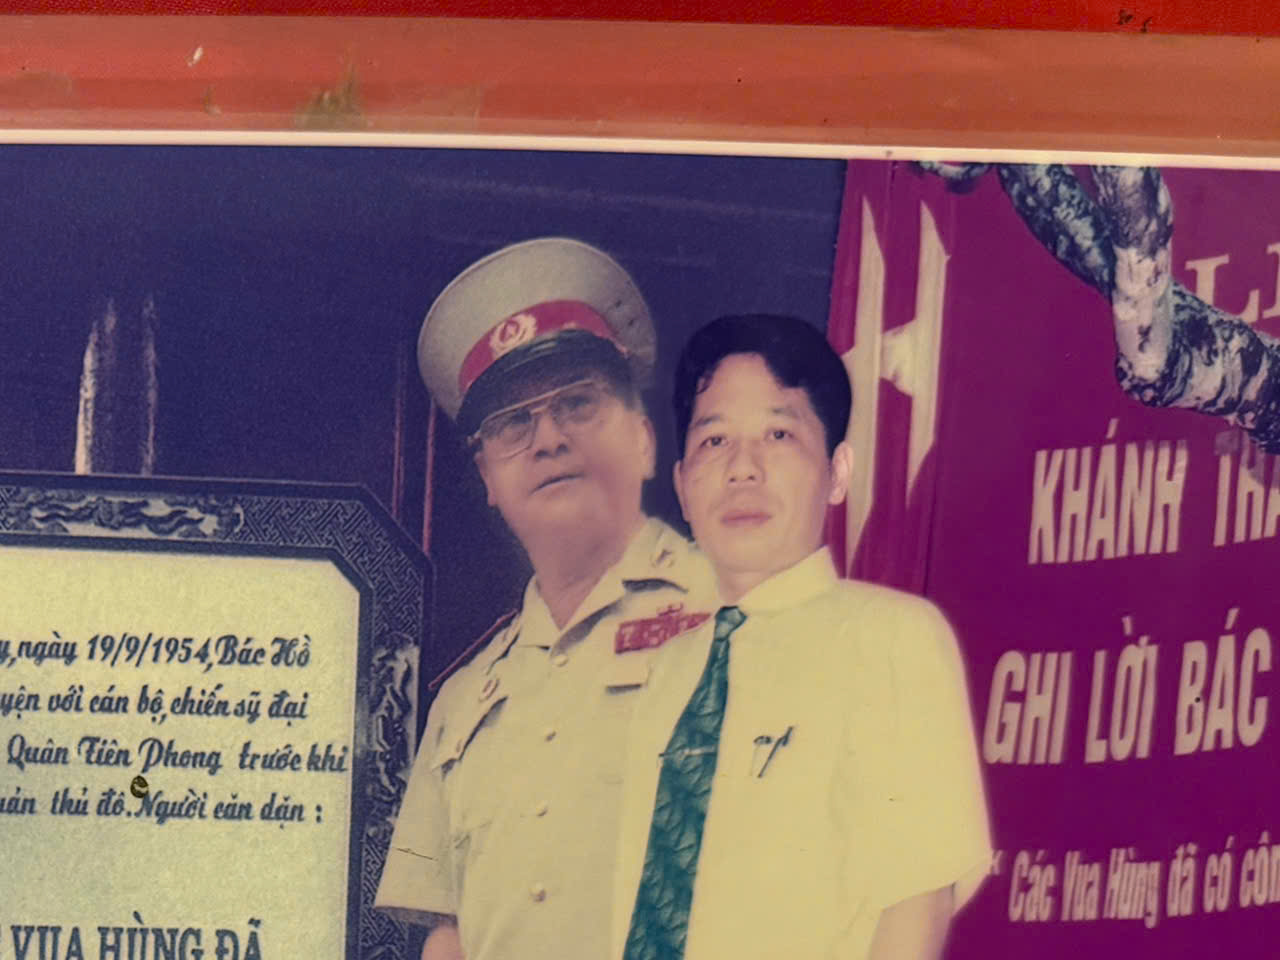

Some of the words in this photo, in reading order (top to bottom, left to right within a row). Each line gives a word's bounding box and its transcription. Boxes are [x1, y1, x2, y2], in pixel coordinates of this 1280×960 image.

[1027, 417, 1188, 565] KHÁNH
[270, 634, 312, 667] Hồ
[47, 684, 85, 712] với
[89, 684, 130, 714] cán
[170, 683, 230, 716] chiến
[233, 691, 262, 724] sỹ
[268, 690, 310, 727] đại
[983, 649, 1074, 765] GHI
[1084, 615, 1160, 765] LỜI
[1173, 607, 1273, 757] BÁC
[7, 734, 70, 771] Quân
[77, 736, 133, 766] Tiên
[138, 737, 223, 776] Phong
[238, 741, 302, 771] trước
[307, 744, 348, 772] khi
[50, 787, 90, 816] thủ
[213, 793, 255, 821] căn
[260, 792, 305, 830] dặn
[1103, 847, 1162, 928] Hùng
[1167, 842, 1198, 918] đã
[1203, 835, 1235, 914] có
